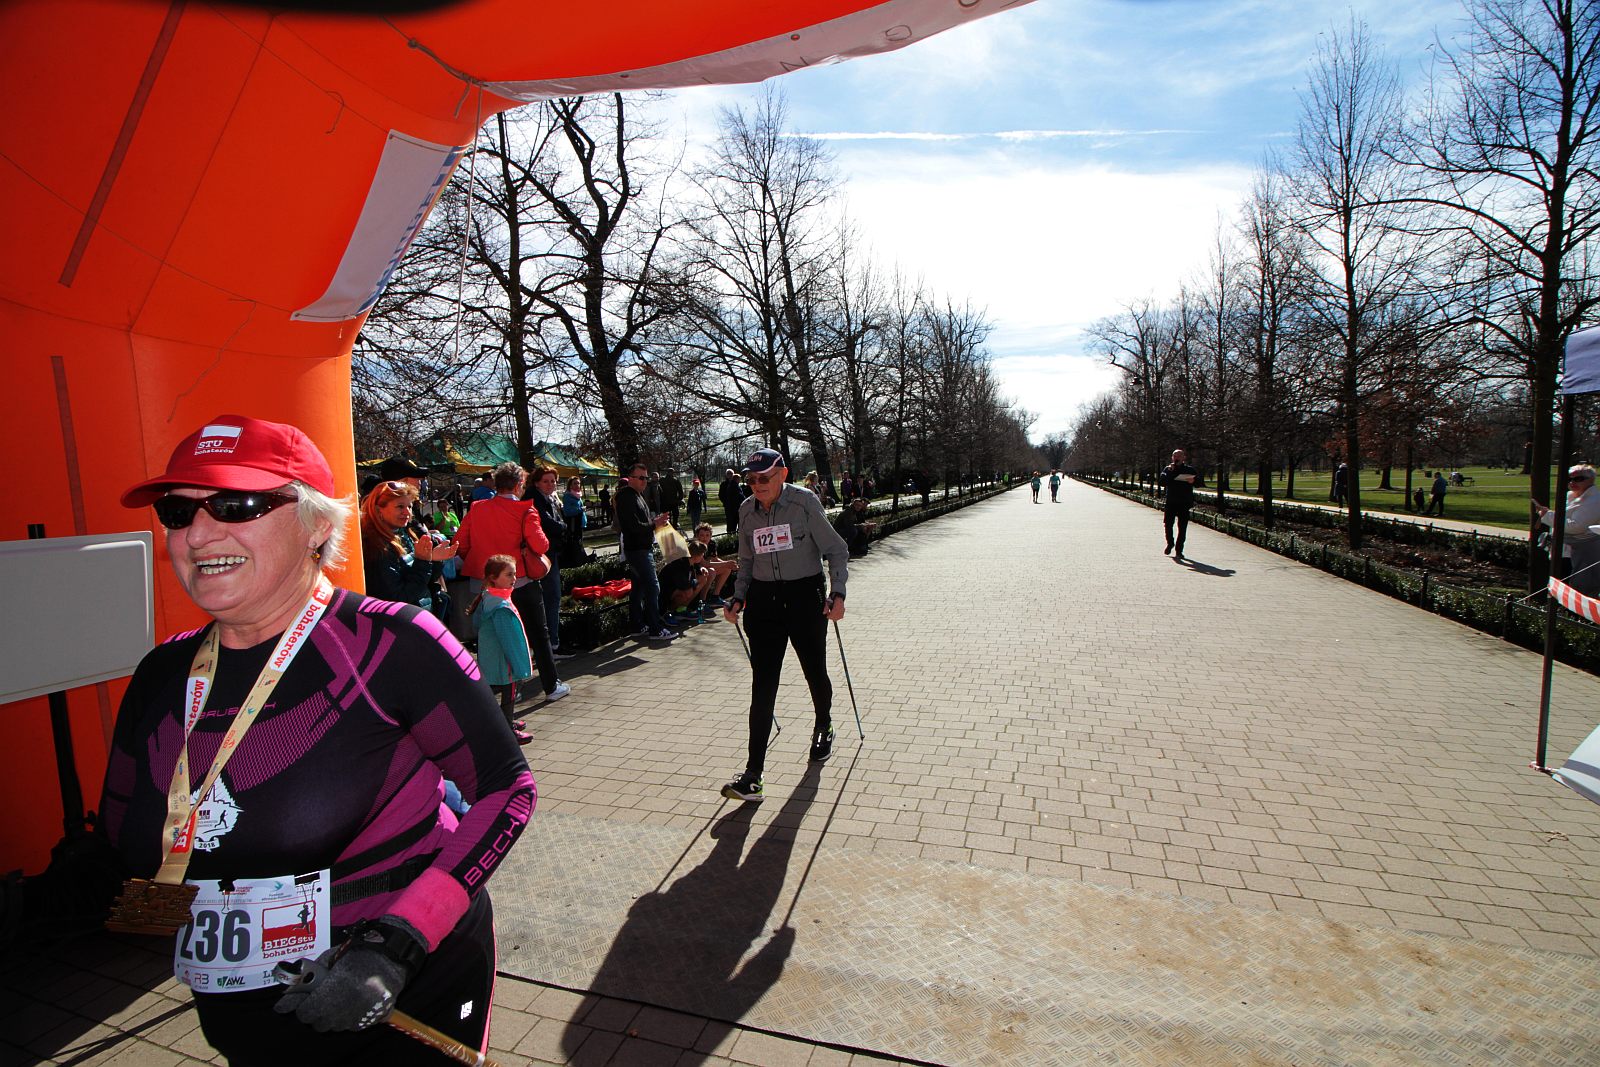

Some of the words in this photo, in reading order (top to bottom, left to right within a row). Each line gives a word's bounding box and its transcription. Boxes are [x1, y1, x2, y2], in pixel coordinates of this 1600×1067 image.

[197, 440, 223, 449] STU
[756, 533, 775, 547] 122
[273, 602, 321, 669] bohaterów
[263, 936, 297, 951] BIEG
[297, 935, 314, 944] stu
[263, 943, 315, 959] bohaterów
